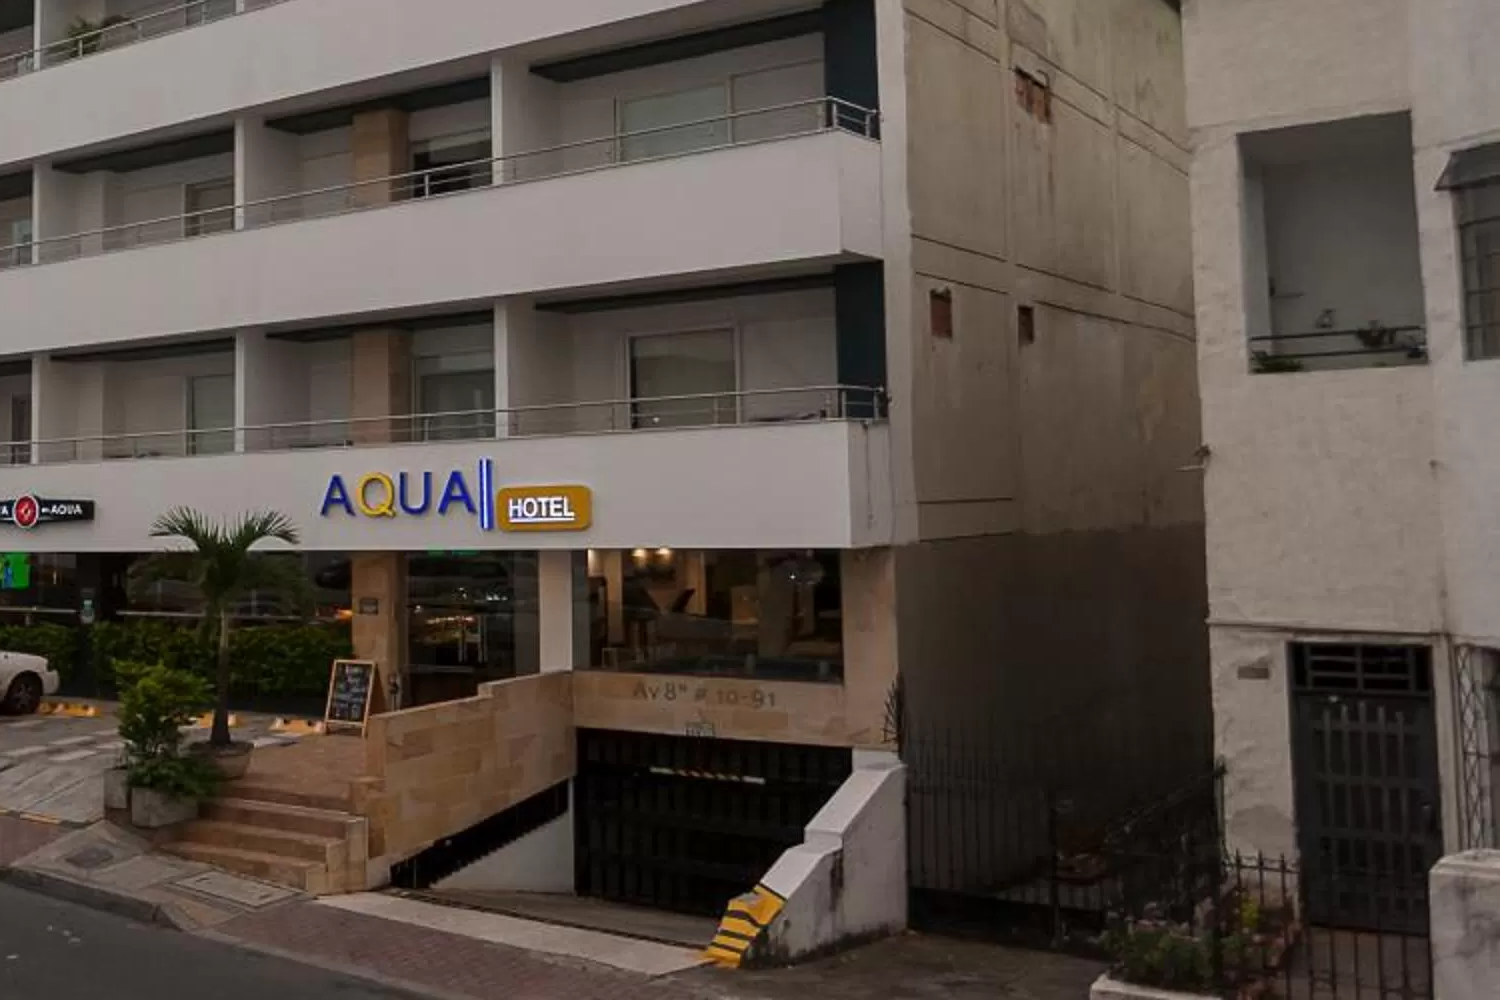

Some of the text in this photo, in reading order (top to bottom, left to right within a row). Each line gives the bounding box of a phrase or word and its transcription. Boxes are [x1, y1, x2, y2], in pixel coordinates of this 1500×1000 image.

[51, 503, 83, 516] AQUA
[320, 470, 575, 519] AQUA HOTEL
